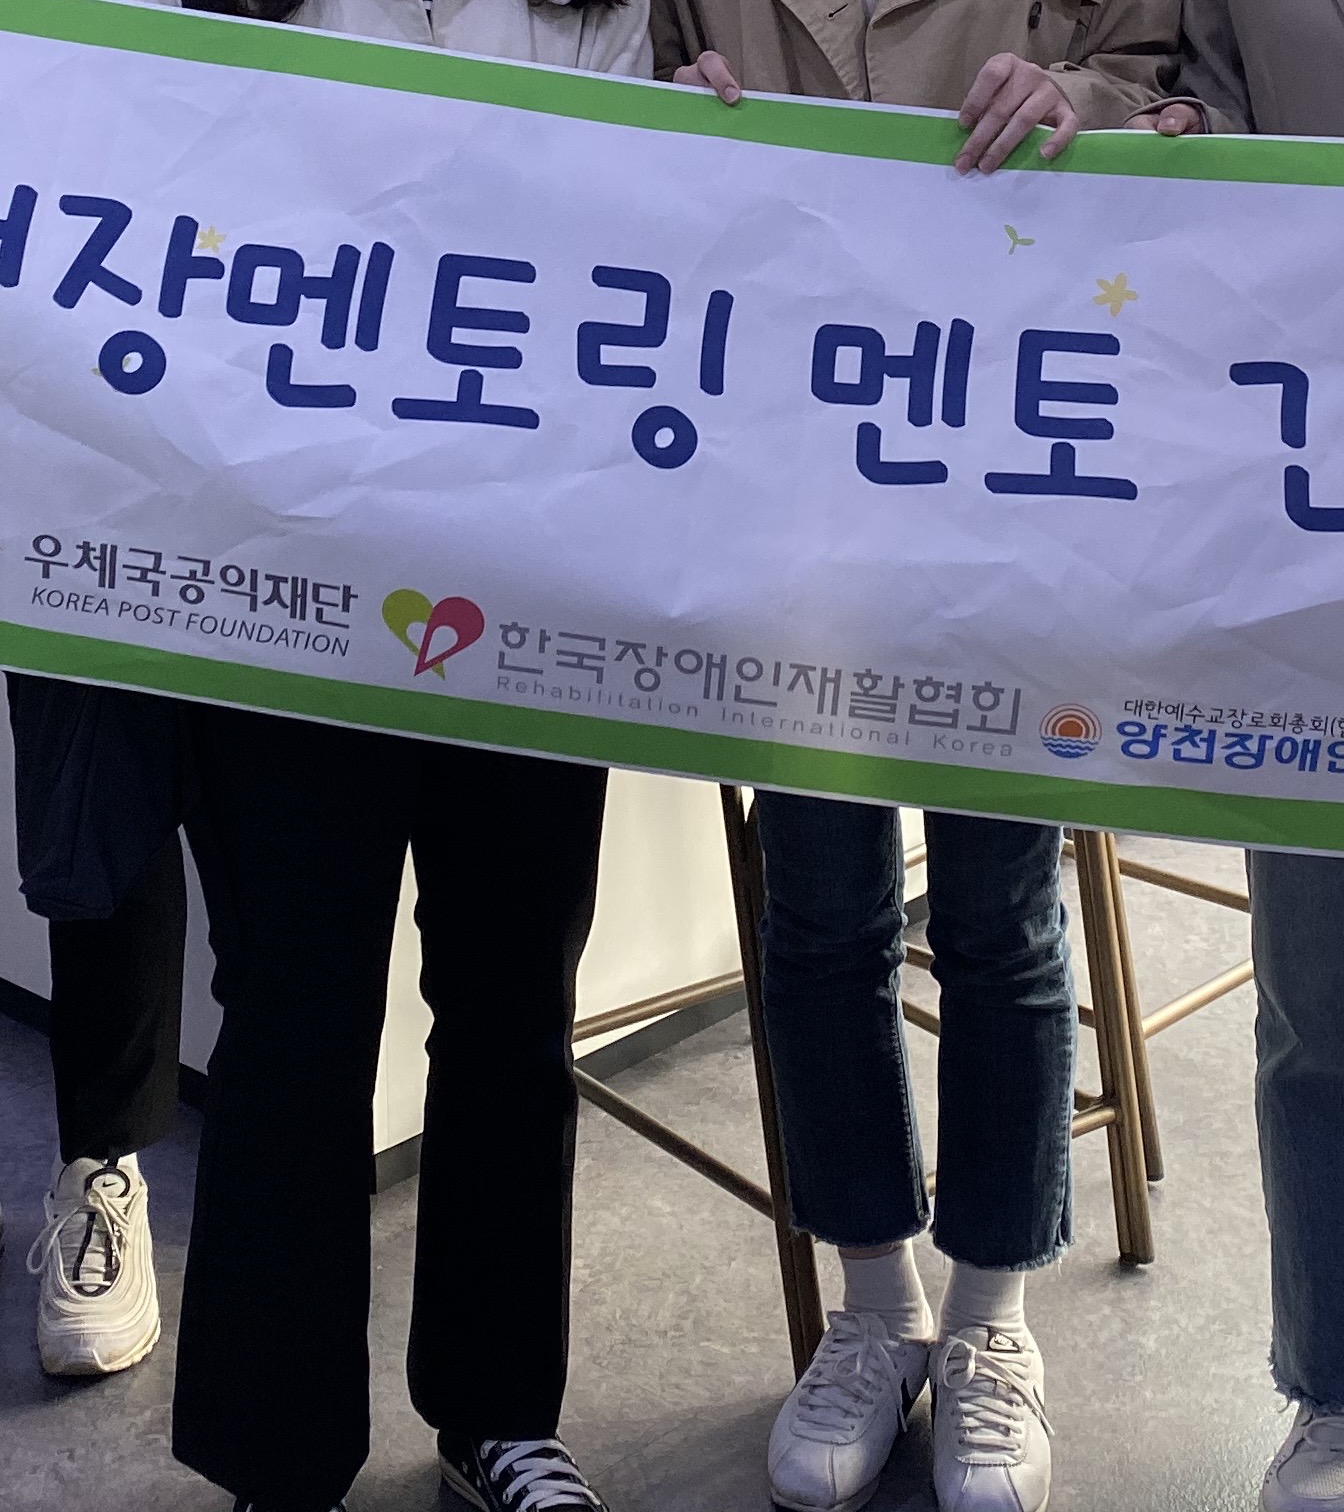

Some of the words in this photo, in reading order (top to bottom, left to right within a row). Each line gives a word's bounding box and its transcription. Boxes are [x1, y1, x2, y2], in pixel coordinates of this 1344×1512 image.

[810, 317, 1139, 501] 멘토
[23, 533, 359, 629] 우체국공익재단
[30, 586, 111, 616] KOREA
[117, 599, 181, 628] POST
[184, 611, 352, 657] FOUNDATION
[496, 675, 699, 719] Rehabilitation
[721, 707, 910, 747] International
[932, 733, 1015, 757] Korea
[497, 621, 1022, 736] 한국장애인재활협회
